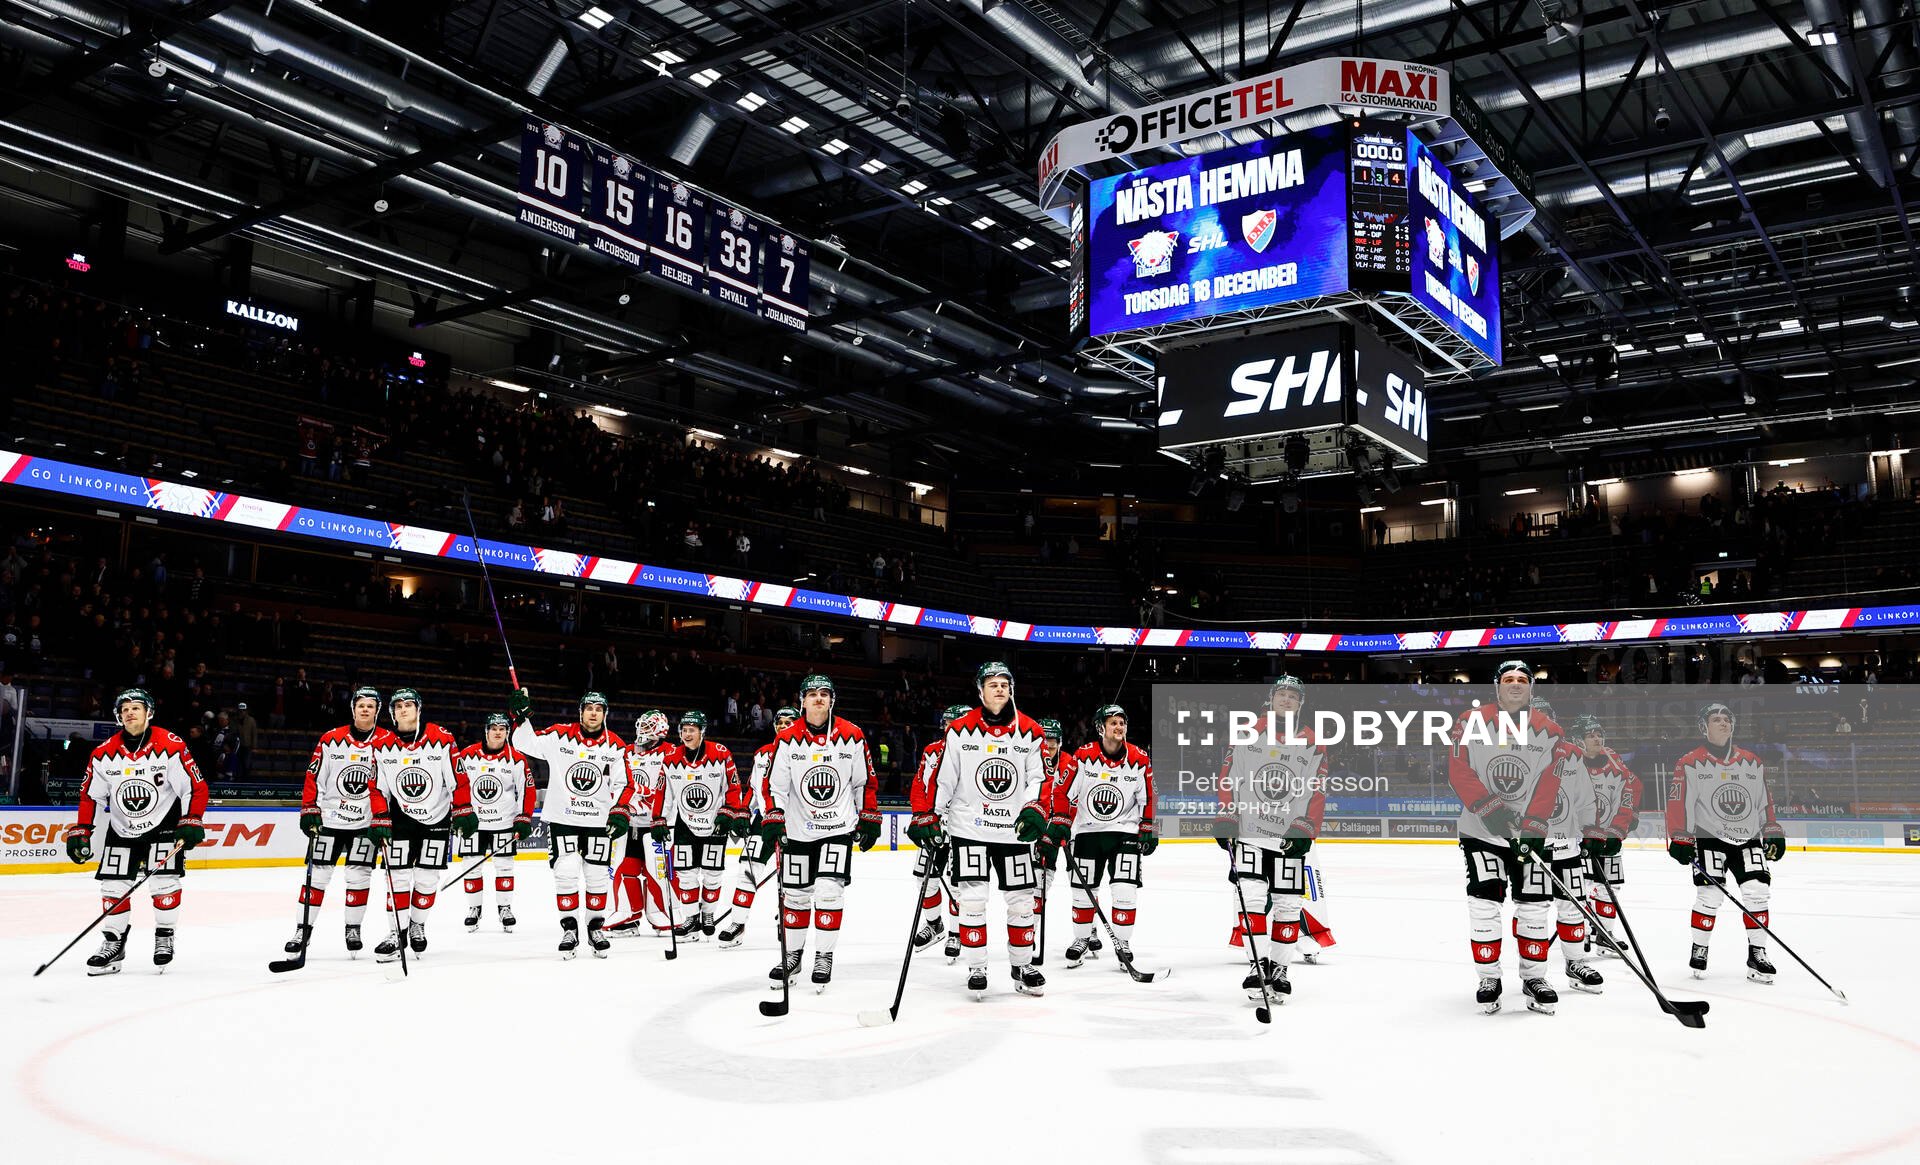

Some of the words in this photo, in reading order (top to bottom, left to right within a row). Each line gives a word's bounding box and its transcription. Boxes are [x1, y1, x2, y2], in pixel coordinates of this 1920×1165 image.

[1404, 64, 1438, 76] LINKÖPING
[1341, 60, 1438, 102] MAXI
[1341, 92, 1358, 103] ICA
[1360, 94, 1438, 112] STORMARKNAD
[1105, 78, 1294, 152] OFFICETEL
[1356, 144, 1403, 161] 000.0
[534, 148, 568, 198] 10
[1376, 173, 1383, 182] 3
[1392, 173, 1400, 184] 4
[1116, 178, 1194, 226] NÄSTA
[1200, 148, 1305, 206] HEMMA
[606, 180, 634, 226] 15
[520, 208, 576, 240] ANDERSSON
[666, 206, 693, 251] 16
[1187, 232, 1229, 254] SHL
[594, 236, 640, 267] JACOBSSON
[720, 230, 751, 275] 33
[661, 264, 693, 287] HELBER
[780, 256, 796, 294] 7
[720, 286, 748, 308] EMVALL
[1124, 282, 1190, 316] TORSDAG
[1194, 279, 1210, 302] 18
[1213, 262, 1298, 300] DECEMBER
[226, 300, 298, 332] KALLZON
[764, 306, 806, 332] JOHANSSON
[1384, 372, 1428, 442] SH
[31, 468, 51, 480] GO
[60, 472, 138, 496] LINKÖPING
[298, 517, 316, 528] GO
[321, 520, 383, 538] LINKÖPING
[456, 543, 470, 553] GO
[642, 572, 654, 581] GO
[658, 574, 703, 588] LINKÖPING
[796, 596, 808, 604] GO
[810, 597, 848, 609] LINKÖPING
[1858, 613, 1874, 621] GO
[1048, 630, 1092, 639] LINKÖPING
[1664, 624, 1677, 632] GO
[1680, 621, 1731, 630] LINKÖPING
[1201, 636, 1243, 644] LINKÖPING
[1350, 639, 1392, 647] LINKÖPING
[1506, 631, 1552, 640] LINKÖPING
[154, 773, 164, 786] C
[1669, 784, 1681, 800] 21
[339, 802, 362, 814] RASTA
[813, 812, 838, 820] RASTA
[983, 808, 1011, 817] RASTA
[1259, 812, 1285, 826] RASTA
[1342, 822, 1381, 834] Saltängen
[1396, 824, 1449, 833] OPTIMERA
[1820, 825, 1870, 840] clean
[5, 848, 57, 858] PROSERO
